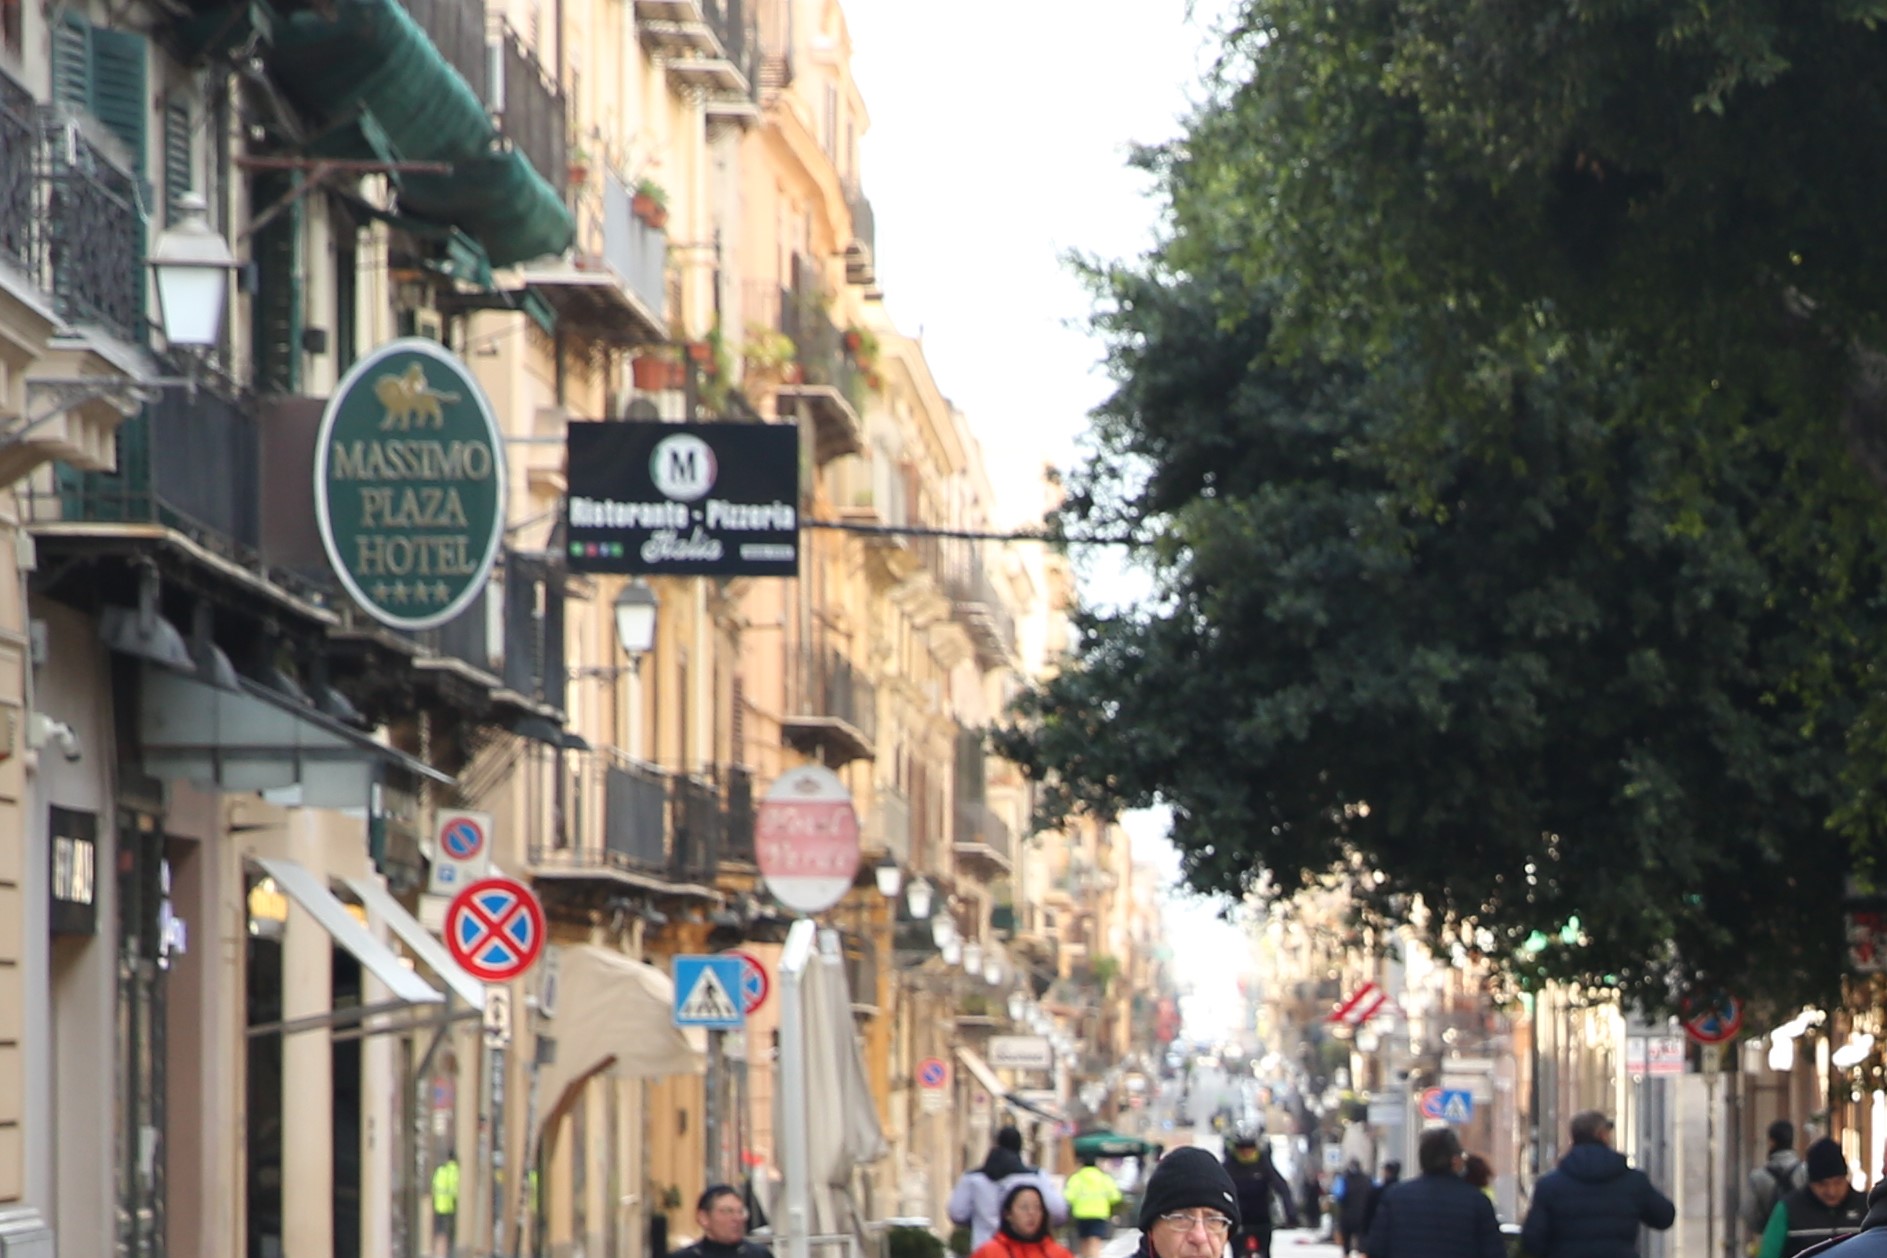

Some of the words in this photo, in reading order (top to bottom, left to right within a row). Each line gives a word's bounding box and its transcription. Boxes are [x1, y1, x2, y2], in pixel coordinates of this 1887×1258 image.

[333, 439, 492, 481] MASSIMO
[671, 450, 697, 483] M
[360, 487, 467, 528] PLAZA
[569, 497, 689, 528] Ristorante
[705, 499, 795, 530] Pizzeria
[357, 535, 478, 576] HOTEL
